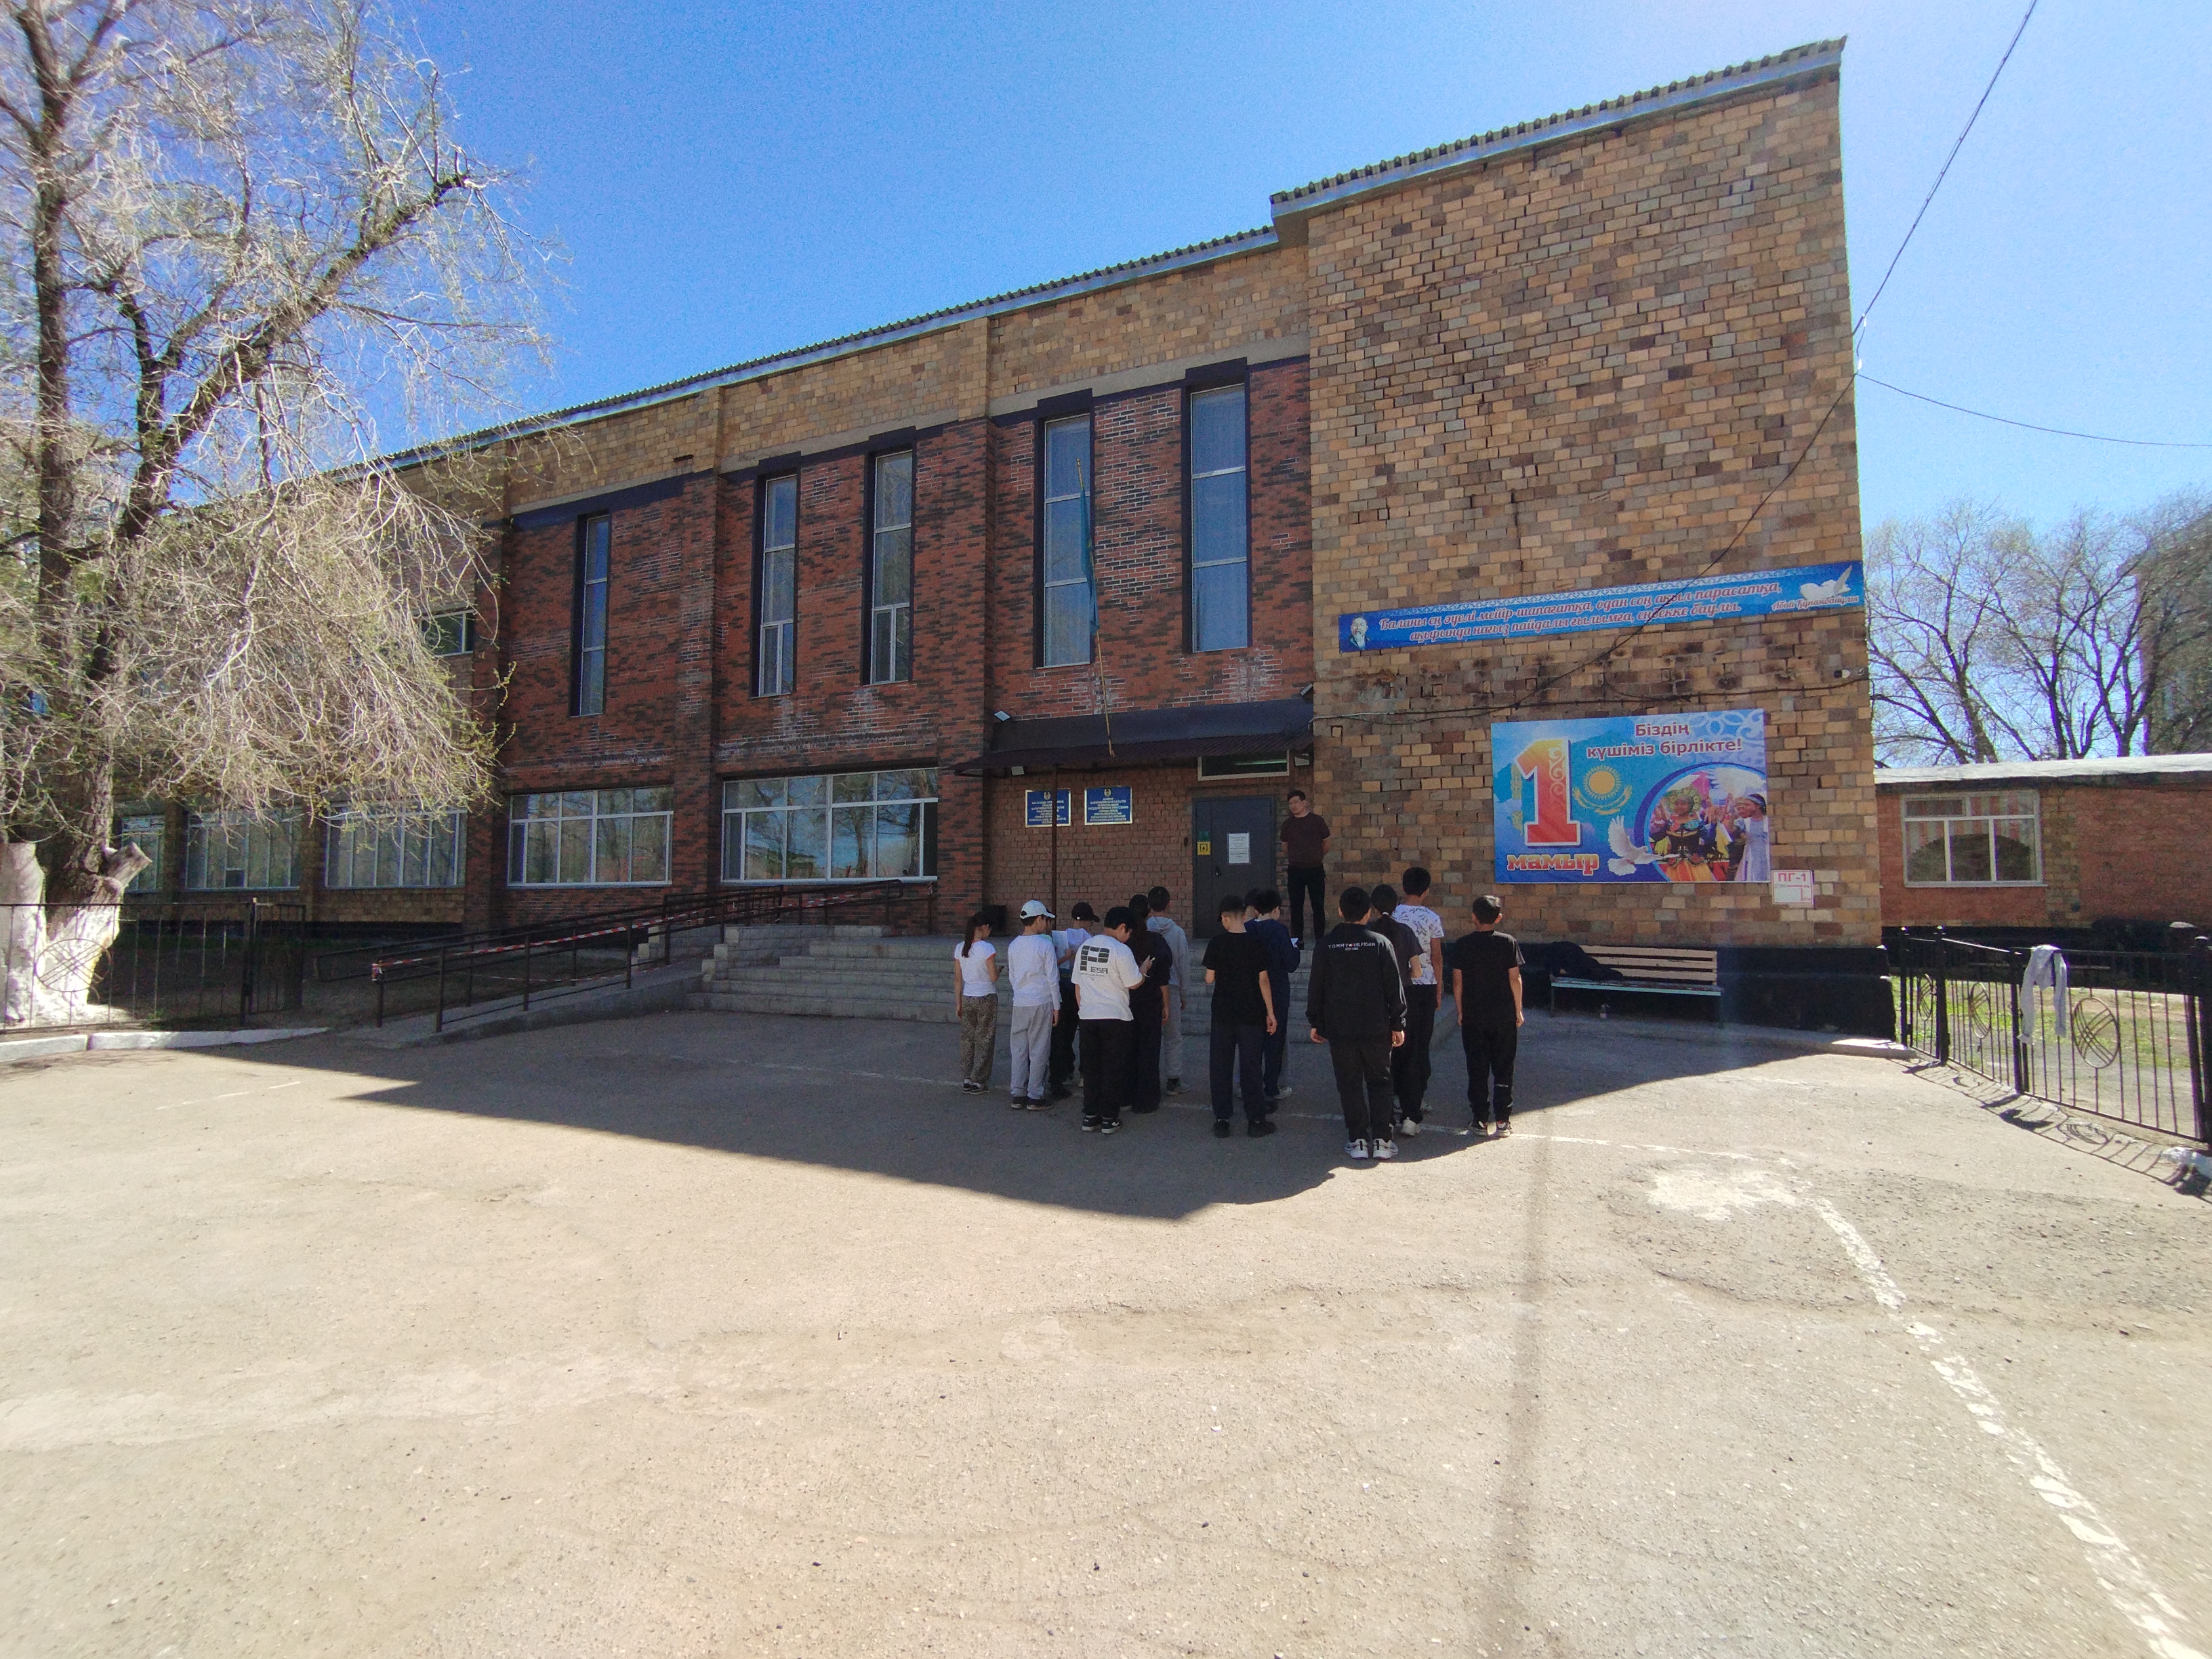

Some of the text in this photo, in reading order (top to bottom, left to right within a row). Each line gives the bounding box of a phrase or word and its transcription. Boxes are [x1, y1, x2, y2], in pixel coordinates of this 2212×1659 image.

[1380, 619, 1427, 630] Баланы
[1596, 598, 1629, 611] одан
[1511, 618, 1569, 633] пайдалы
[1635, 722, 1689, 737] Біздің
[1587, 738, 1742, 760] күшіміз бірлікте!
[1515, 739, 1580, 847] 1
[1507, 853, 1599, 876] мамыр
[1778, 873, 1806, 882] ПГ-1
